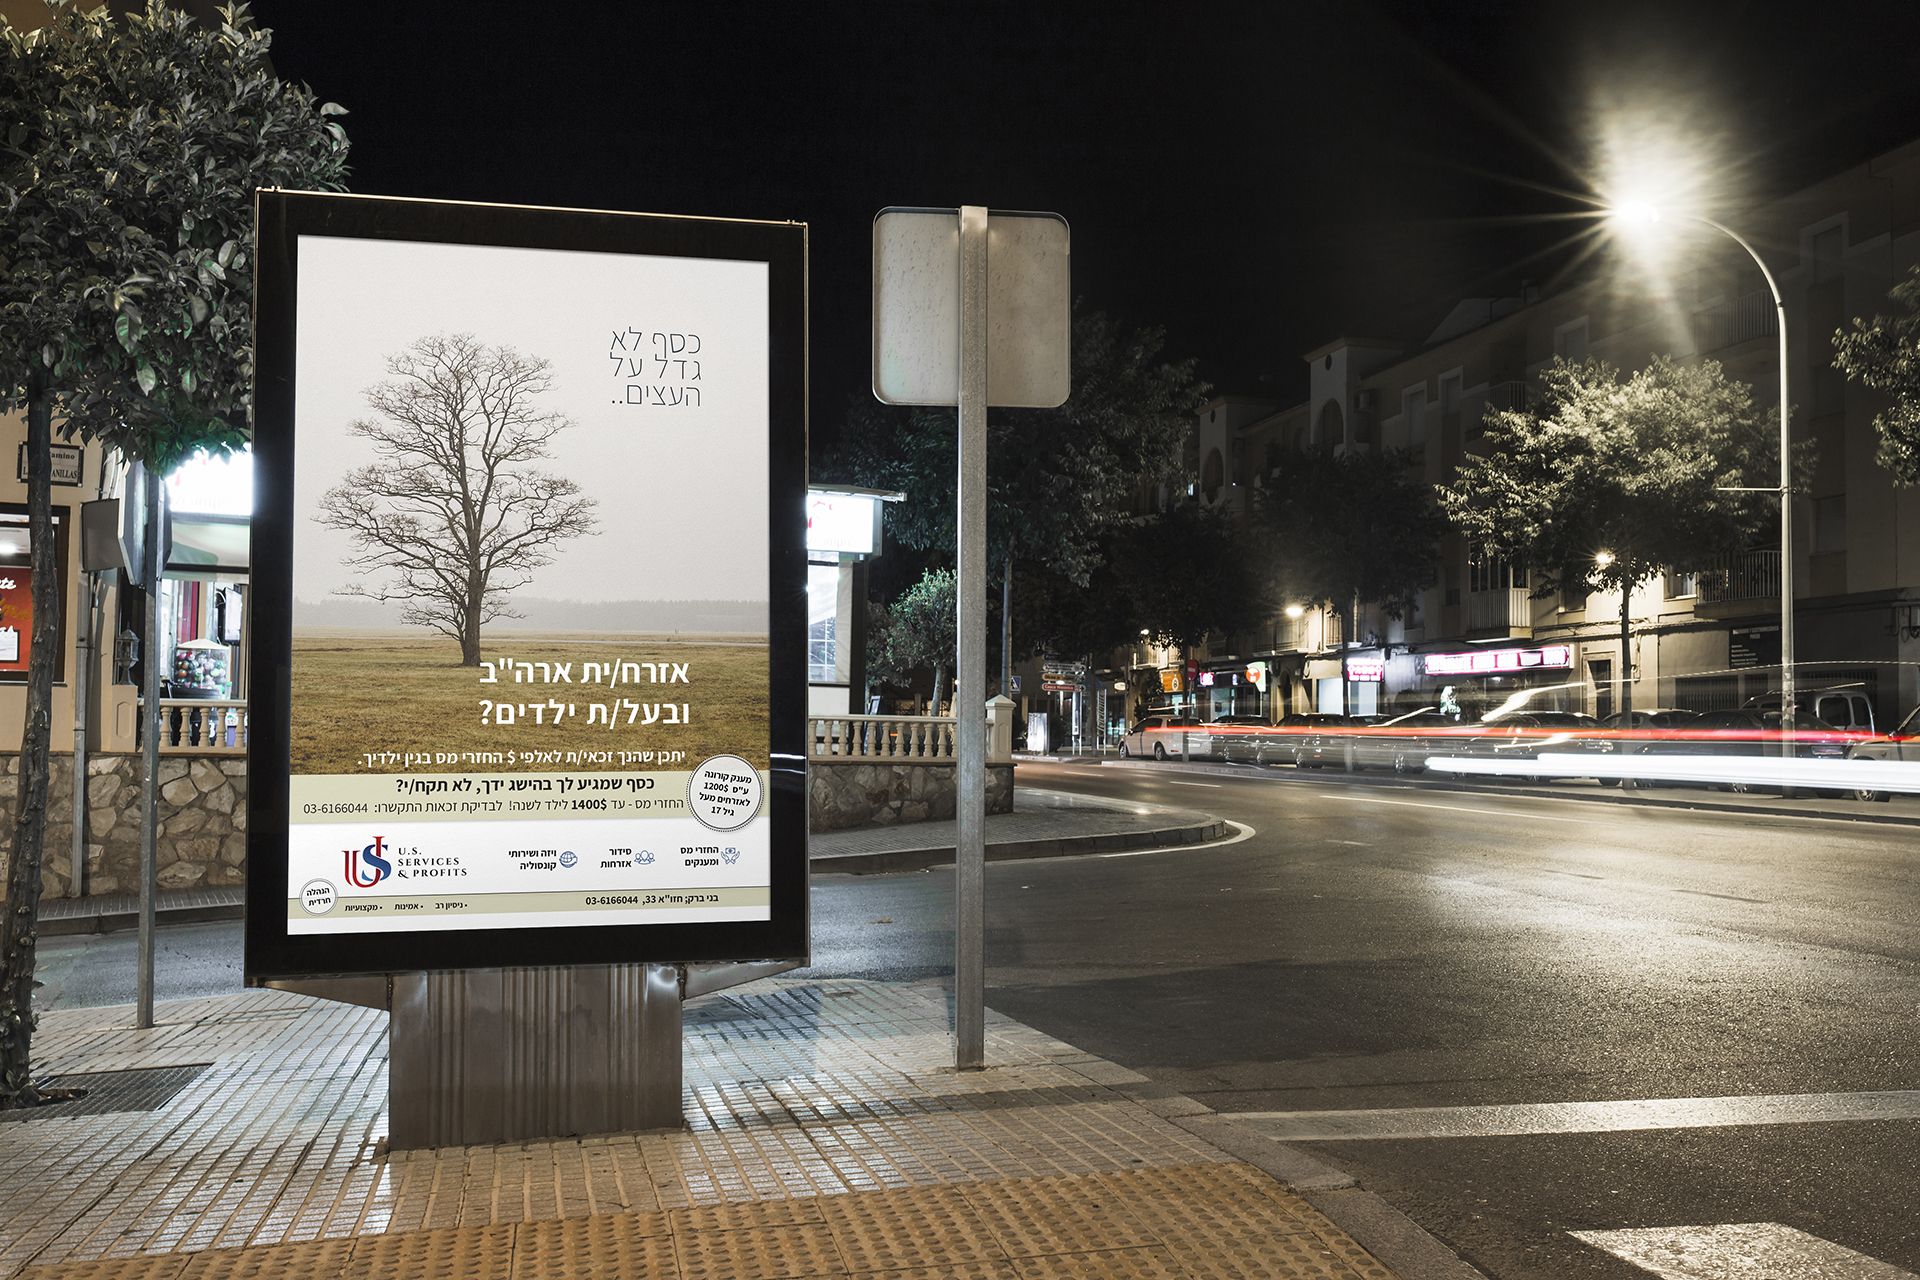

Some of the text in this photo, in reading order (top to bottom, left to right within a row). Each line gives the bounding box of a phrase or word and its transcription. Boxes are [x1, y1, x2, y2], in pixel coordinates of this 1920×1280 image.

[610, 325, 701, 359] כסף לא
[609, 351, 702, 380] גדל על
[611, 384, 701, 406] העצים..
[52, 468, 78, 479] ANILLAS
[479, 657, 690, 689] אזרח/ית ארה"ב
[478, 698, 690, 730] ובעל/ת ילדים?
[357, 749, 686, 768] יתכן שהנך זכאי/ת לאלפי $ החזרי מס בגין ילדיך.
[704, 771, 752, 784] מענק קורונה
[396, 776, 655, 796] כסף שמגיע לך בהישג ידך, לא תקח/י?
[704, 782, 729, 793] 1200$
[508, 799, 542, 811] לשנה!
[544, 798, 569, 811] לילד
[610, 800, 626, 810] עד
[635, 799, 652, 810] מס
[653, 798, 685, 810] החזרי
[699, 792, 751, 807] לאזרחים מעל
[303, 803, 368, 814] 03-6166044
[374, 801, 422, 816] התקשרו:
[425, 801, 457, 813] זכאות
[460, 799, 503, 815] לבדיקת
[571, 799, 608, 812] 1400$
[711, 806, 735, 817] גיל 17
[398, 846, 422, 856] U.S.
[508, 849, 557, 859] ויזה ושירותי
[608, 848, 632, 857] סידור
[680, 845, 719, 855] החזרי מס
[397, 857, 460, 867] SERVICES
[519, 860, 557, 872] קונסוליה
[600, 860, 632, 869] אזרחות
[684, 858, 719, 868] ומענקים
[397, 868, 467, 879] & PROFITS
[306, 886, 330, 897] הנהלה
[308, 896, 332, 907] חרדית
[585, 895, 639, 906] 03-6166044
[642, 895, 657, 906] 33,
[705, 893, 719, 903] בני
[344, 904, 379, 913] מקצועיות
[394, 903, 419, 911] אמינות
[435, 902, 464, 911] ניסיון רב
